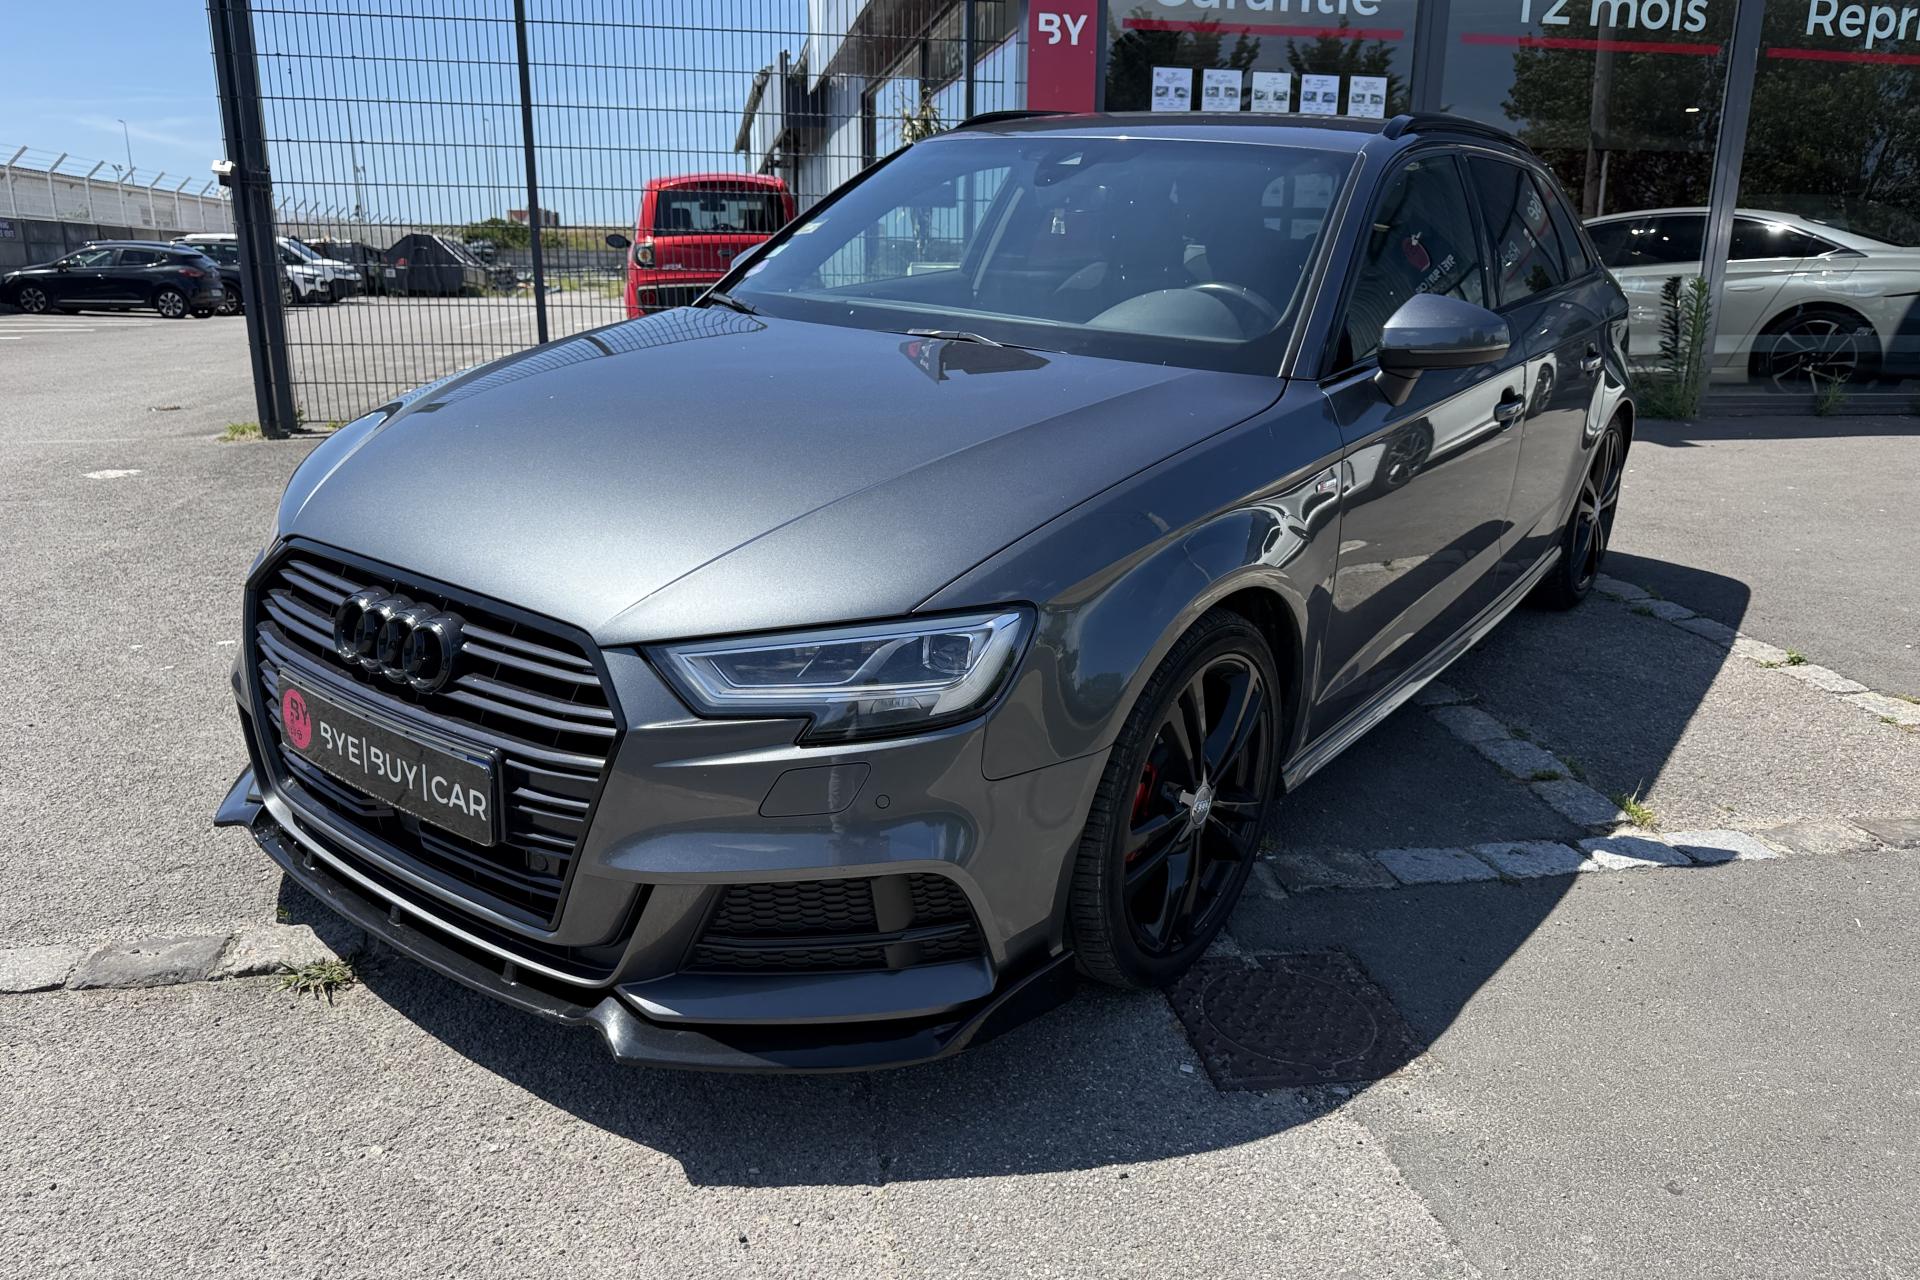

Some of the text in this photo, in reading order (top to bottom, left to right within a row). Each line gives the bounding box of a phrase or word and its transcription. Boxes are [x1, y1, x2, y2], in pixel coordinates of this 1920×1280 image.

[1038, 12, 1088, 46] BY
[1588, 0, 1708, 33] mois
[1806, 0, 1920, 50] Repr
